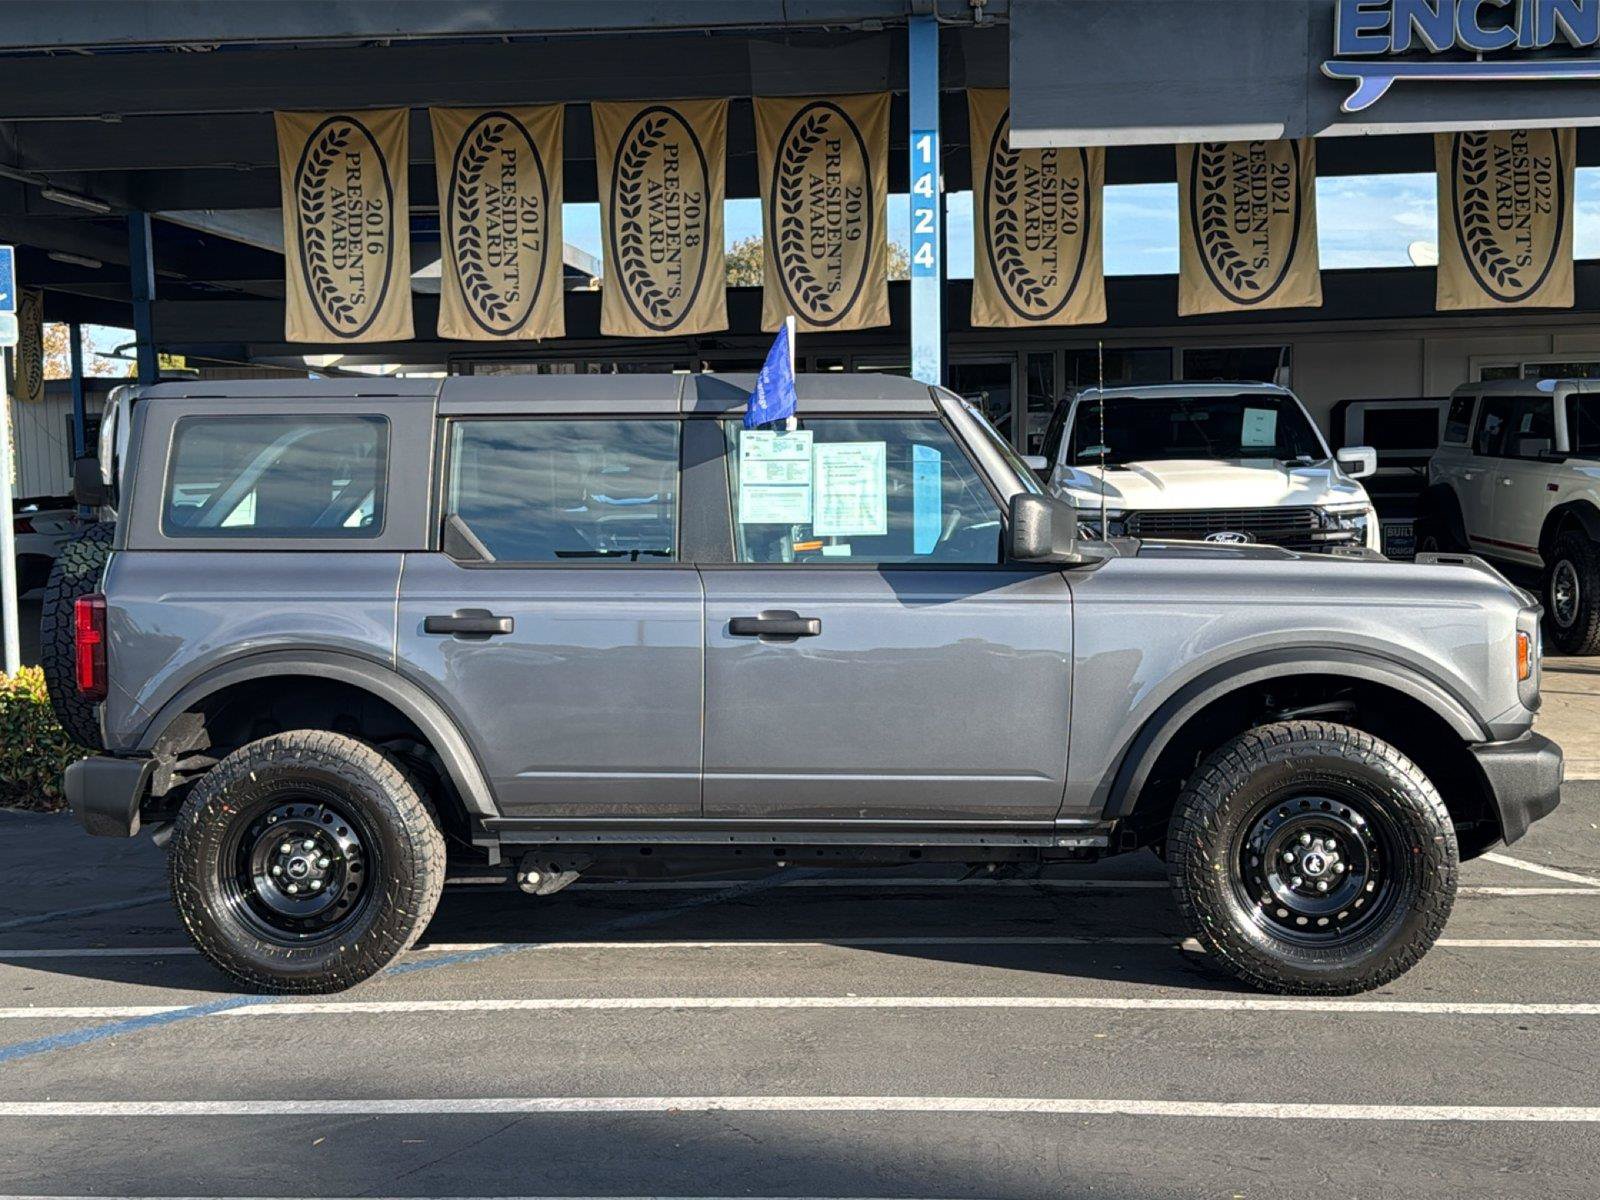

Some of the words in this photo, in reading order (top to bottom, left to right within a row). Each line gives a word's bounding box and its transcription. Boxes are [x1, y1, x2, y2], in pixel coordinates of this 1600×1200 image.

[331, 187, 348, 270] AWARD
[345, 152, 365, 305] PRESIDENT'S
[366, 199, 384, 256] 2016
[485, 183, 502, 268] AWARD
[502, 148, 519, 302] PRESIDENT'S
[521, 196, 539, 252] 2017
[648, 179, 664, 264] AWARD
[663, 143, 681, 298] PRESIDENT'S
[683, 191, 700, 247] 2018
[809, 174, 826, 260] AWARD
[826, 138, 842, 292] PRESIDENT'S
[845, 186, 862, 241] 2019
[1024, 164, 1040, 251] AWARD
[1041, 148, 1057, 287] RESIDENT'S
[1061, 178, 1079, 235] 2020
[1233, 152, 1251, 234] AWARD
[1271, 163, 1291, 215] 2021
[1494, 144, 1513, 231] AWARD
[1511, 130, 1532, 267] RESIDENT'S
[1534, 157, 1552, 215] 2022
